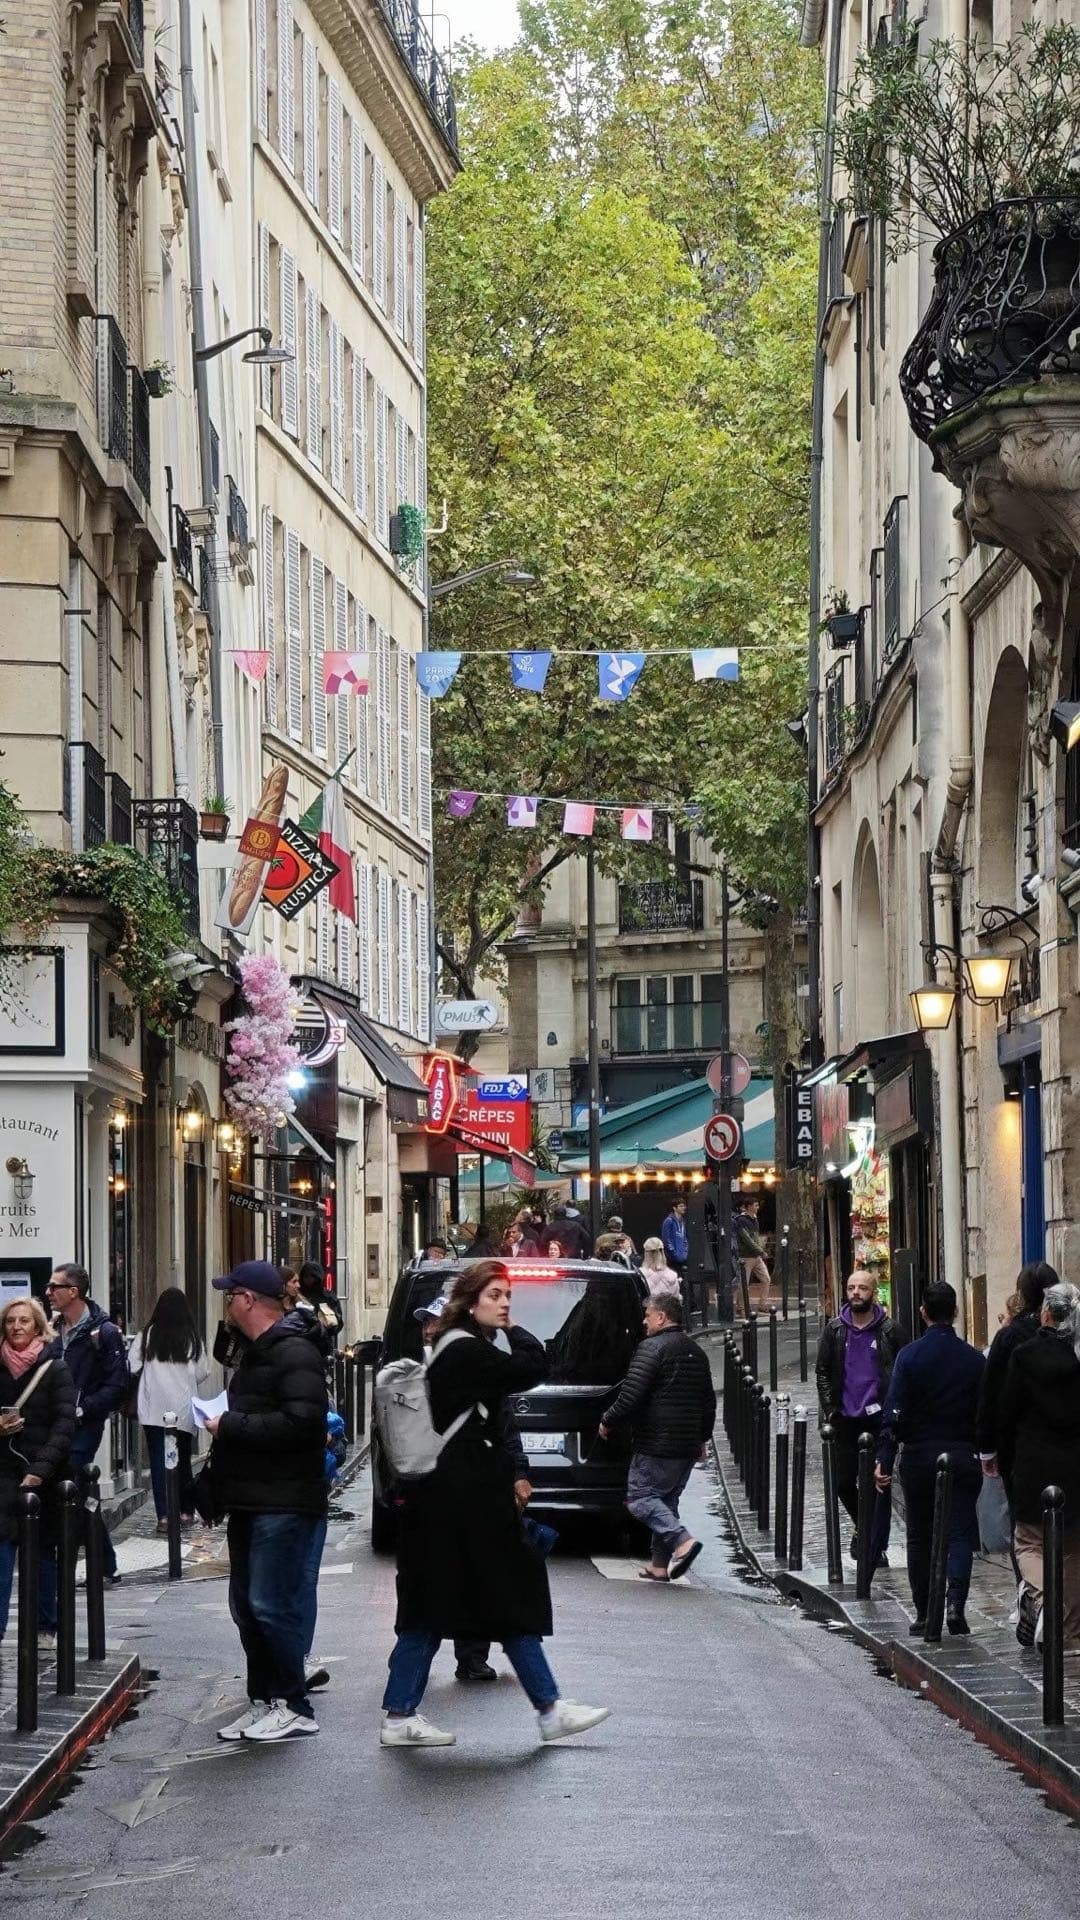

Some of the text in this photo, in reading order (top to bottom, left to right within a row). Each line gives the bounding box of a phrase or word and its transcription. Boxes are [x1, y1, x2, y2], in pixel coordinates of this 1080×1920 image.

[425, 666, 452, 675] PARIS
[281, 826, 314, 864] PIZZA
[279, 865, 333, 915] RUSTICA
[443, 1011, 473, 1023] PMU
[431, 1067, 446, 1121] TABAC
[483, 1083, 504, 1093] FDJ
[459, 1107, 515, 1123] CRÊPES
[0, 1116, 60, 1142] taurant
[9, 1223, 41, 1238] Mer
